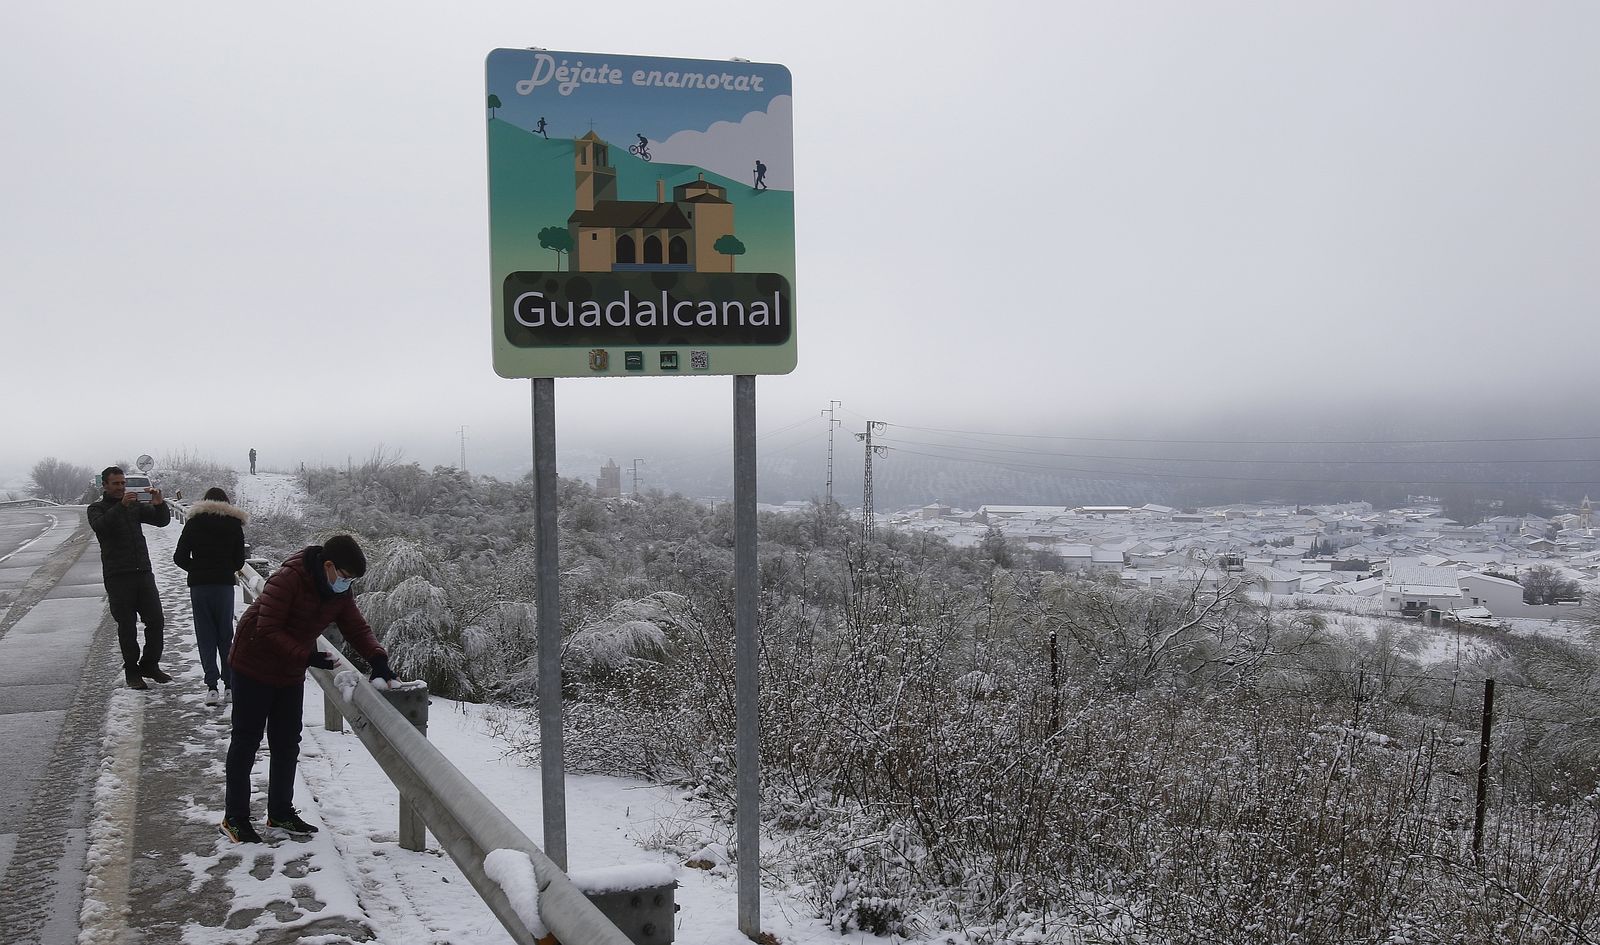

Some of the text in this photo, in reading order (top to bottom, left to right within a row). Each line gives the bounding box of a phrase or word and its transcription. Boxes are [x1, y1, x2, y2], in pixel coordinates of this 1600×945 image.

[515, 53, 764, 96] Déjate enamorar
[513, 290, 781, 327] Guadalcanal
